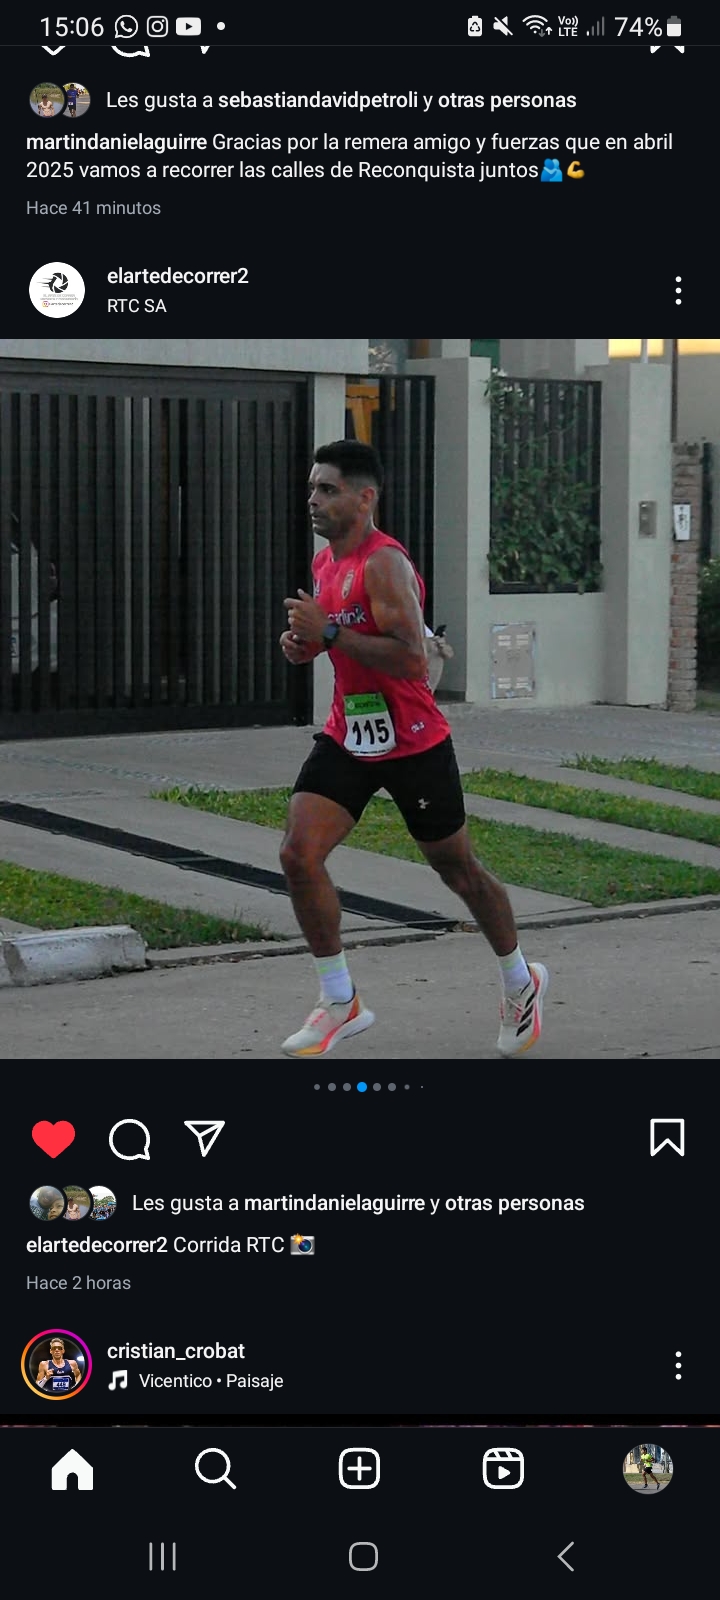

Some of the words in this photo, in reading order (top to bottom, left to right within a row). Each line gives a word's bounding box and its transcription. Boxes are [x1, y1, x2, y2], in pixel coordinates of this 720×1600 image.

[40, 16, 105, 38] 15:06
[558, 27, 579, 37] LTE
[614, 16, 663, 38] 74%
[106, 91, 139, 109] Les
[144, 92, 198, 113] gusta
[202, 94, 214, 109] a
[218, 90, 418, 113] sebastiandavidpetroli
[422, 95, 434, 113] y
[437, 92, 485, 109] otras
[490, 94, 577, 113] personas
[26, 132, 208, 155] martindanielaguirre
[212, 133, 282, 151] Gracias
[287, 136, 319, 155] por
[323, 132, 340, 151] la
[344, 136, 409, 151] remera
[413, 133, 471, 155] amigo
[475, 137, 487, 155] y
[490, 132, 560, 151] fuerzas
[565, 136, 601, 155] que
[605, 136, 628, 151] en
[633, 132, 673, 151] abril
[26, 161, 74, 179] 2025
[78, 164, 141, 179] vamos
[146, 164, 158, 179] a
[162, 164, 235, 179] recorrer
[239, 160, 266, 179] las
[271, 160, 325, 179] calles
[330, 160, 354, 179] de
[358, 161, 476, 183] Reconquista
[478, 161, 539, 183] juntos
[26, 200, 68, 215] Hace
[71, 200, 90, 215] 41
[96, 200, 162, 215] minutos
[106, 266, 250, 285] elartedecorrer2
[107, 298, 140, 314] RTC
[143, 298, 168, 314] SA
[352, 718, 390, 746] 115
[132, 1194, 165, 1212] Les
[170, 1195, 224, 1216] gusta
[228, 1197, 240, 1212] a
[244, 1193, 426, 1216] martindanielaguirre
[429, 1198, 441, 1216] y
[444, 1195, 493, 1212] otras
[498, 1197, 585, 1216] personas
[25, 1235, 169, 1254] elartedecorrer2
[173, 1235, 242, 1254] Corrida
[246, 1236, 285, 1254] RTC
[26, 1275, 68, 1290] Hace
[72, 1275, 83, 1290] 2
[86, 1274, 132, 1290] horas
[106, 1341, 246, 1361] cristian_crobat
[138, 1373, 213, 1389] Vicentico
[226, 1373, 284, 1392] Paisaje
